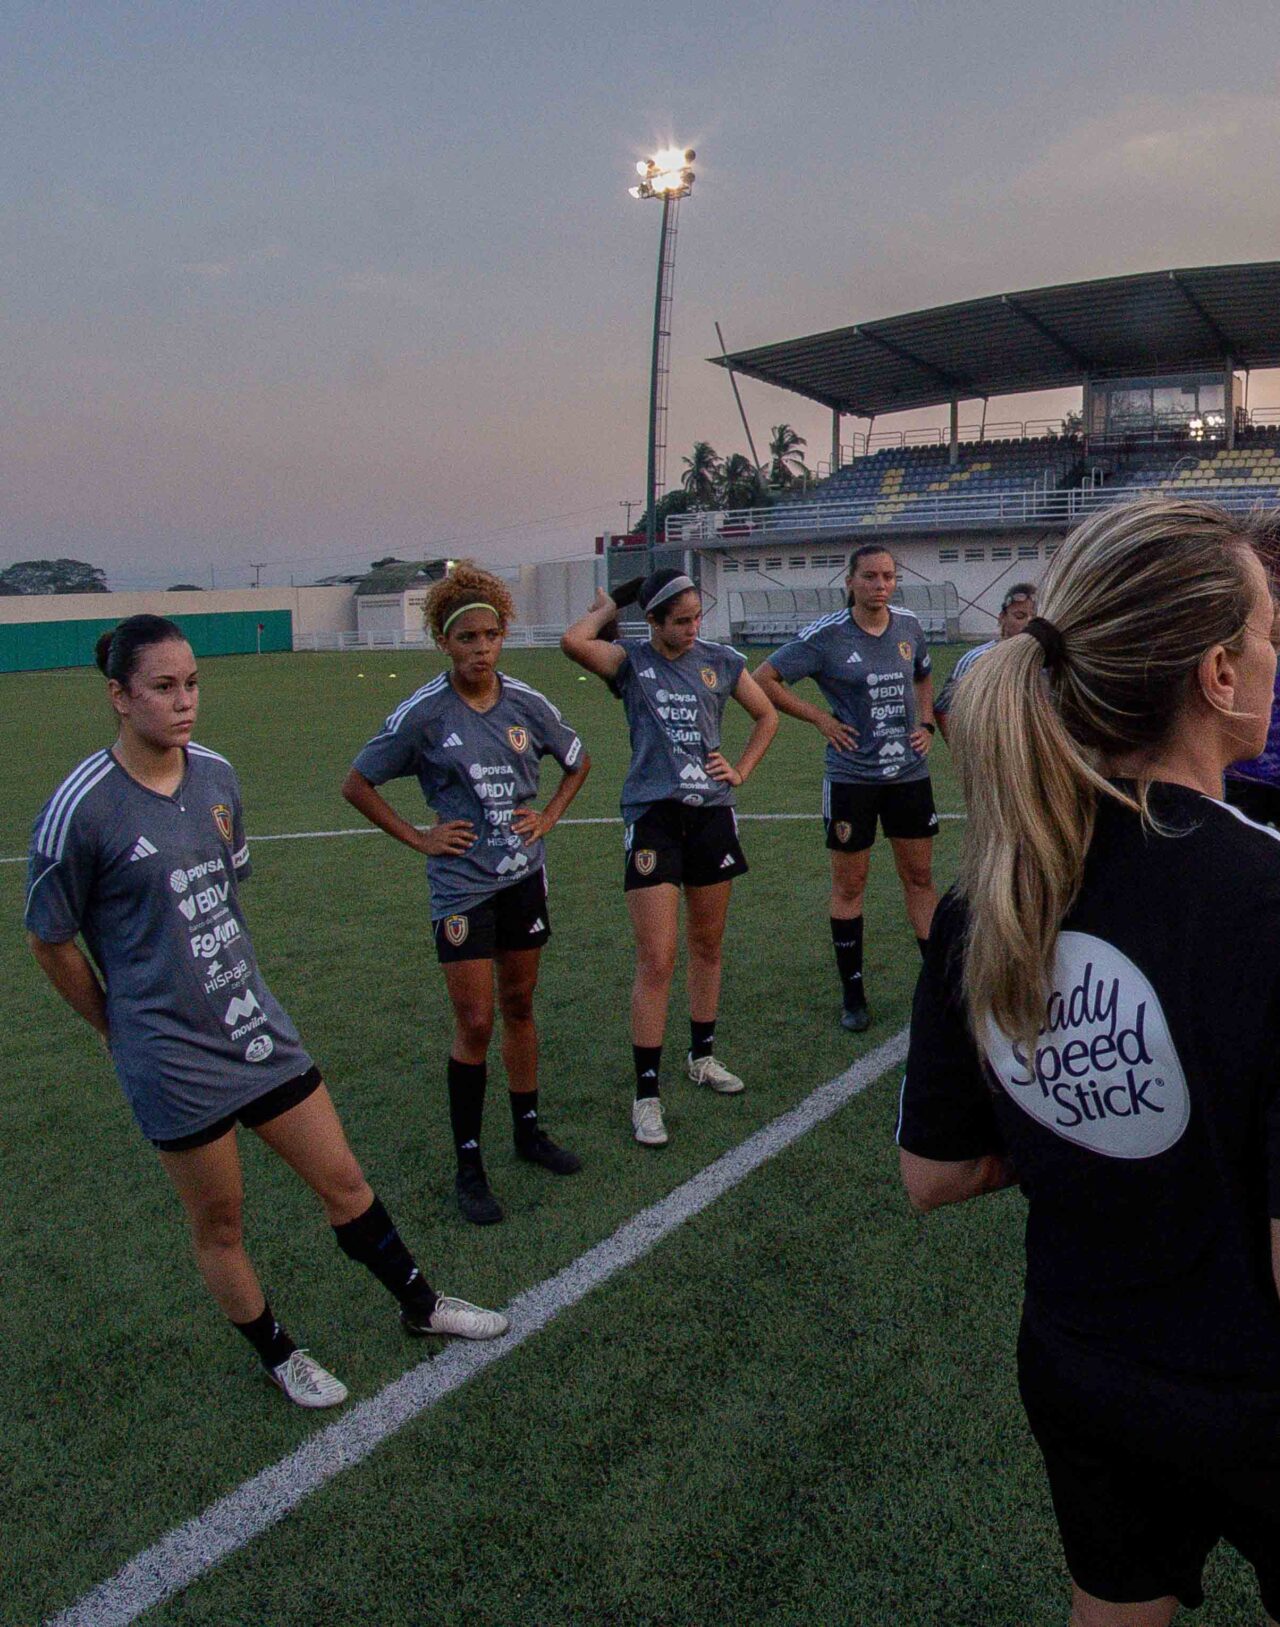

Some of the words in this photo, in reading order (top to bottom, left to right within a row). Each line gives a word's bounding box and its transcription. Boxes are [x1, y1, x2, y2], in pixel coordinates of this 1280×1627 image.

[878, 671, 904, 681] PDVSA
[880, 684, 905, 698] BDV
[671, 708, 698, 722] BDV
[871, 705, 906, 720] Forum
[482, 765, 514, 776] PDVSA
[187, 858, 225, 882] PDVSA
[195, 881, 230, 914] BDV
[1039, 962, 1120, 1038] ady
[1011, 1001, 1154, 1098] Speed
